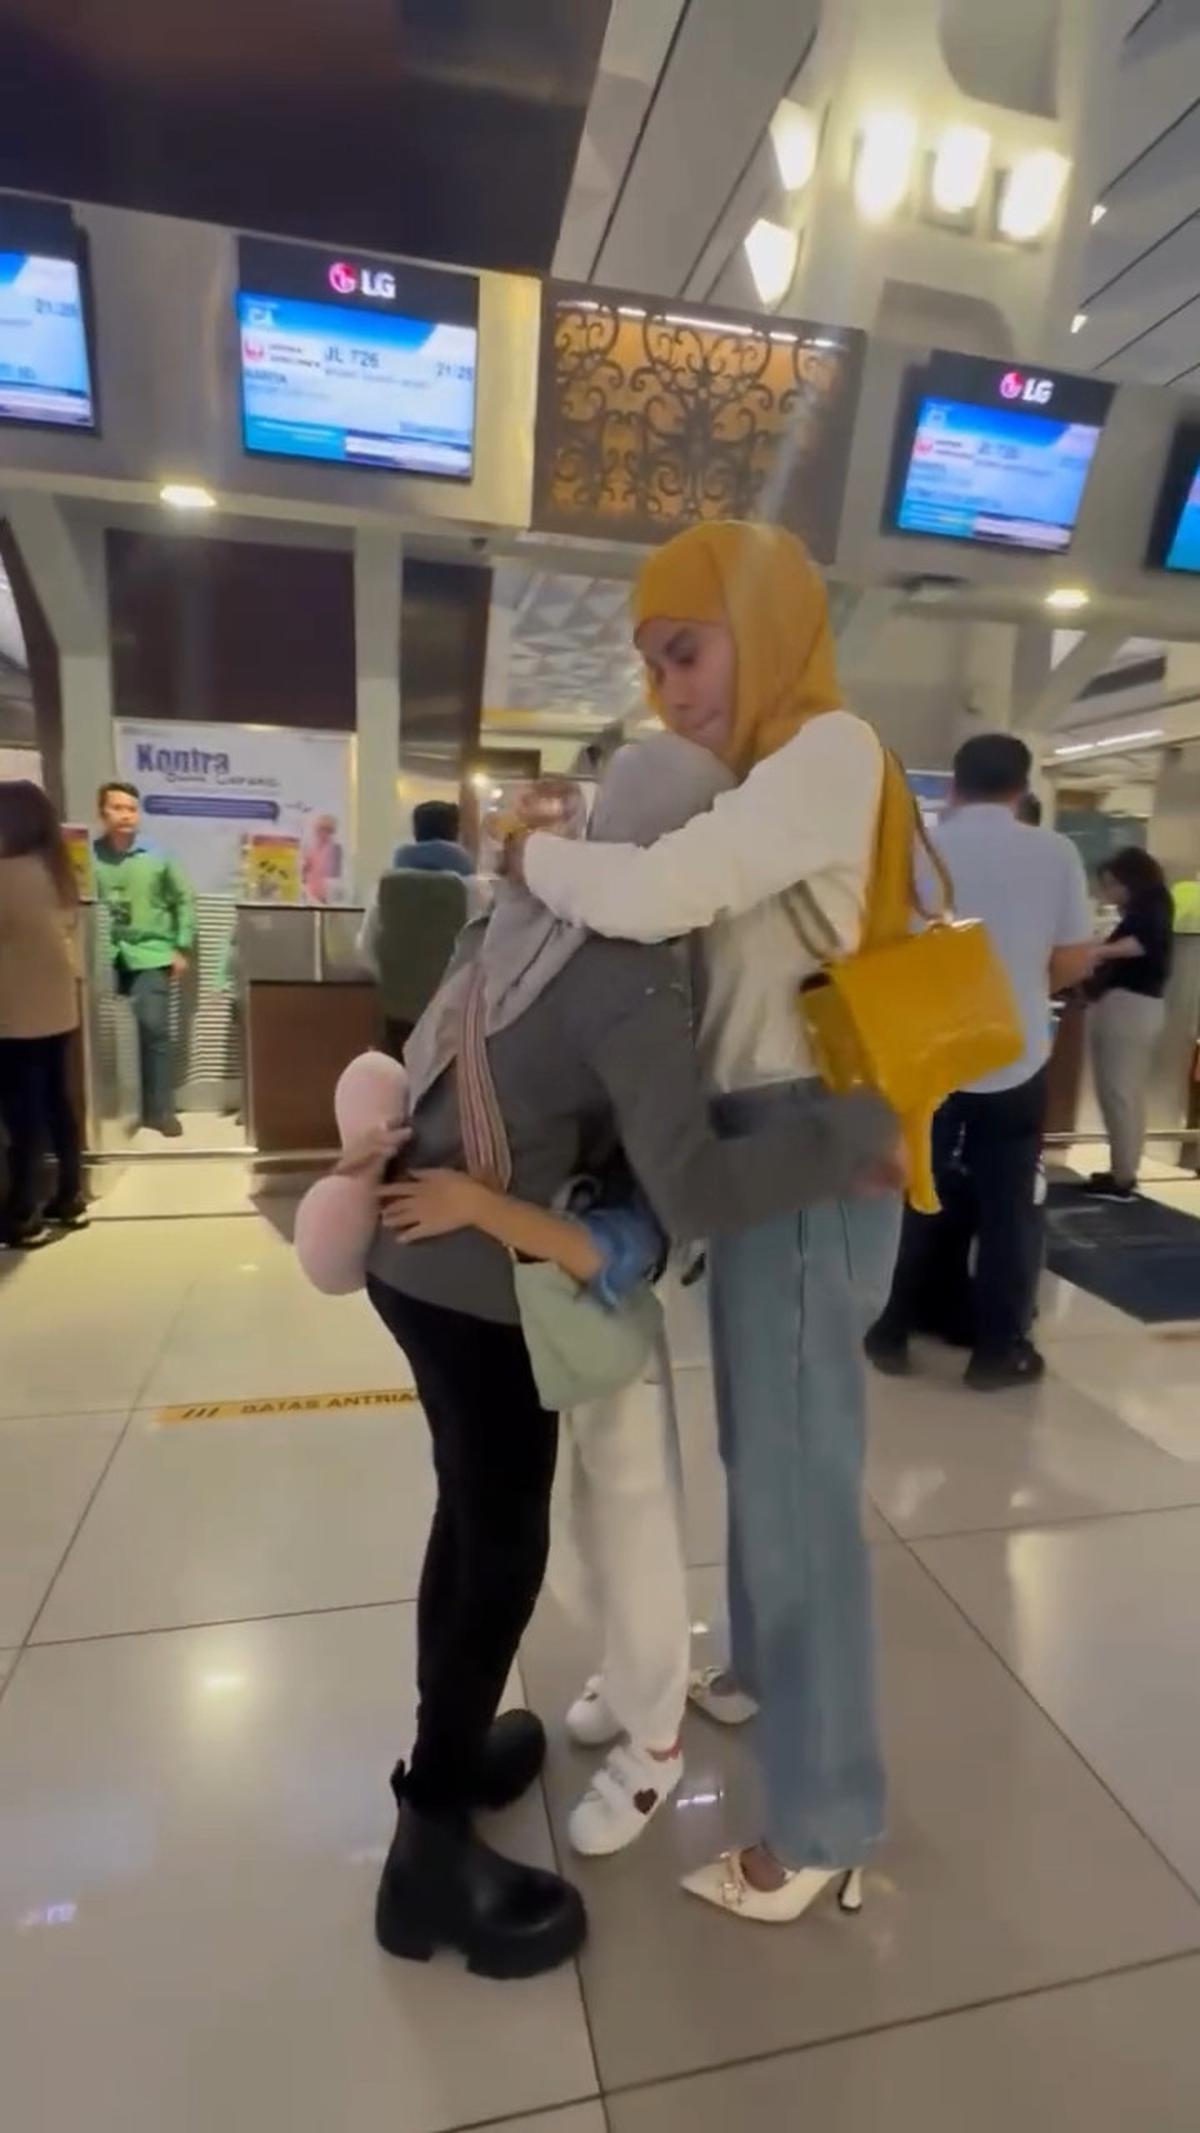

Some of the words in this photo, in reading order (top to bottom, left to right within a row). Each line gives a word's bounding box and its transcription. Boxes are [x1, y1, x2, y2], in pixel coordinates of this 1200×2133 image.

[361, 270, 396, 298] LG
[1022, 380, 1053, 404] LG
[327, 1392, 418, 1409] ANTRIA
